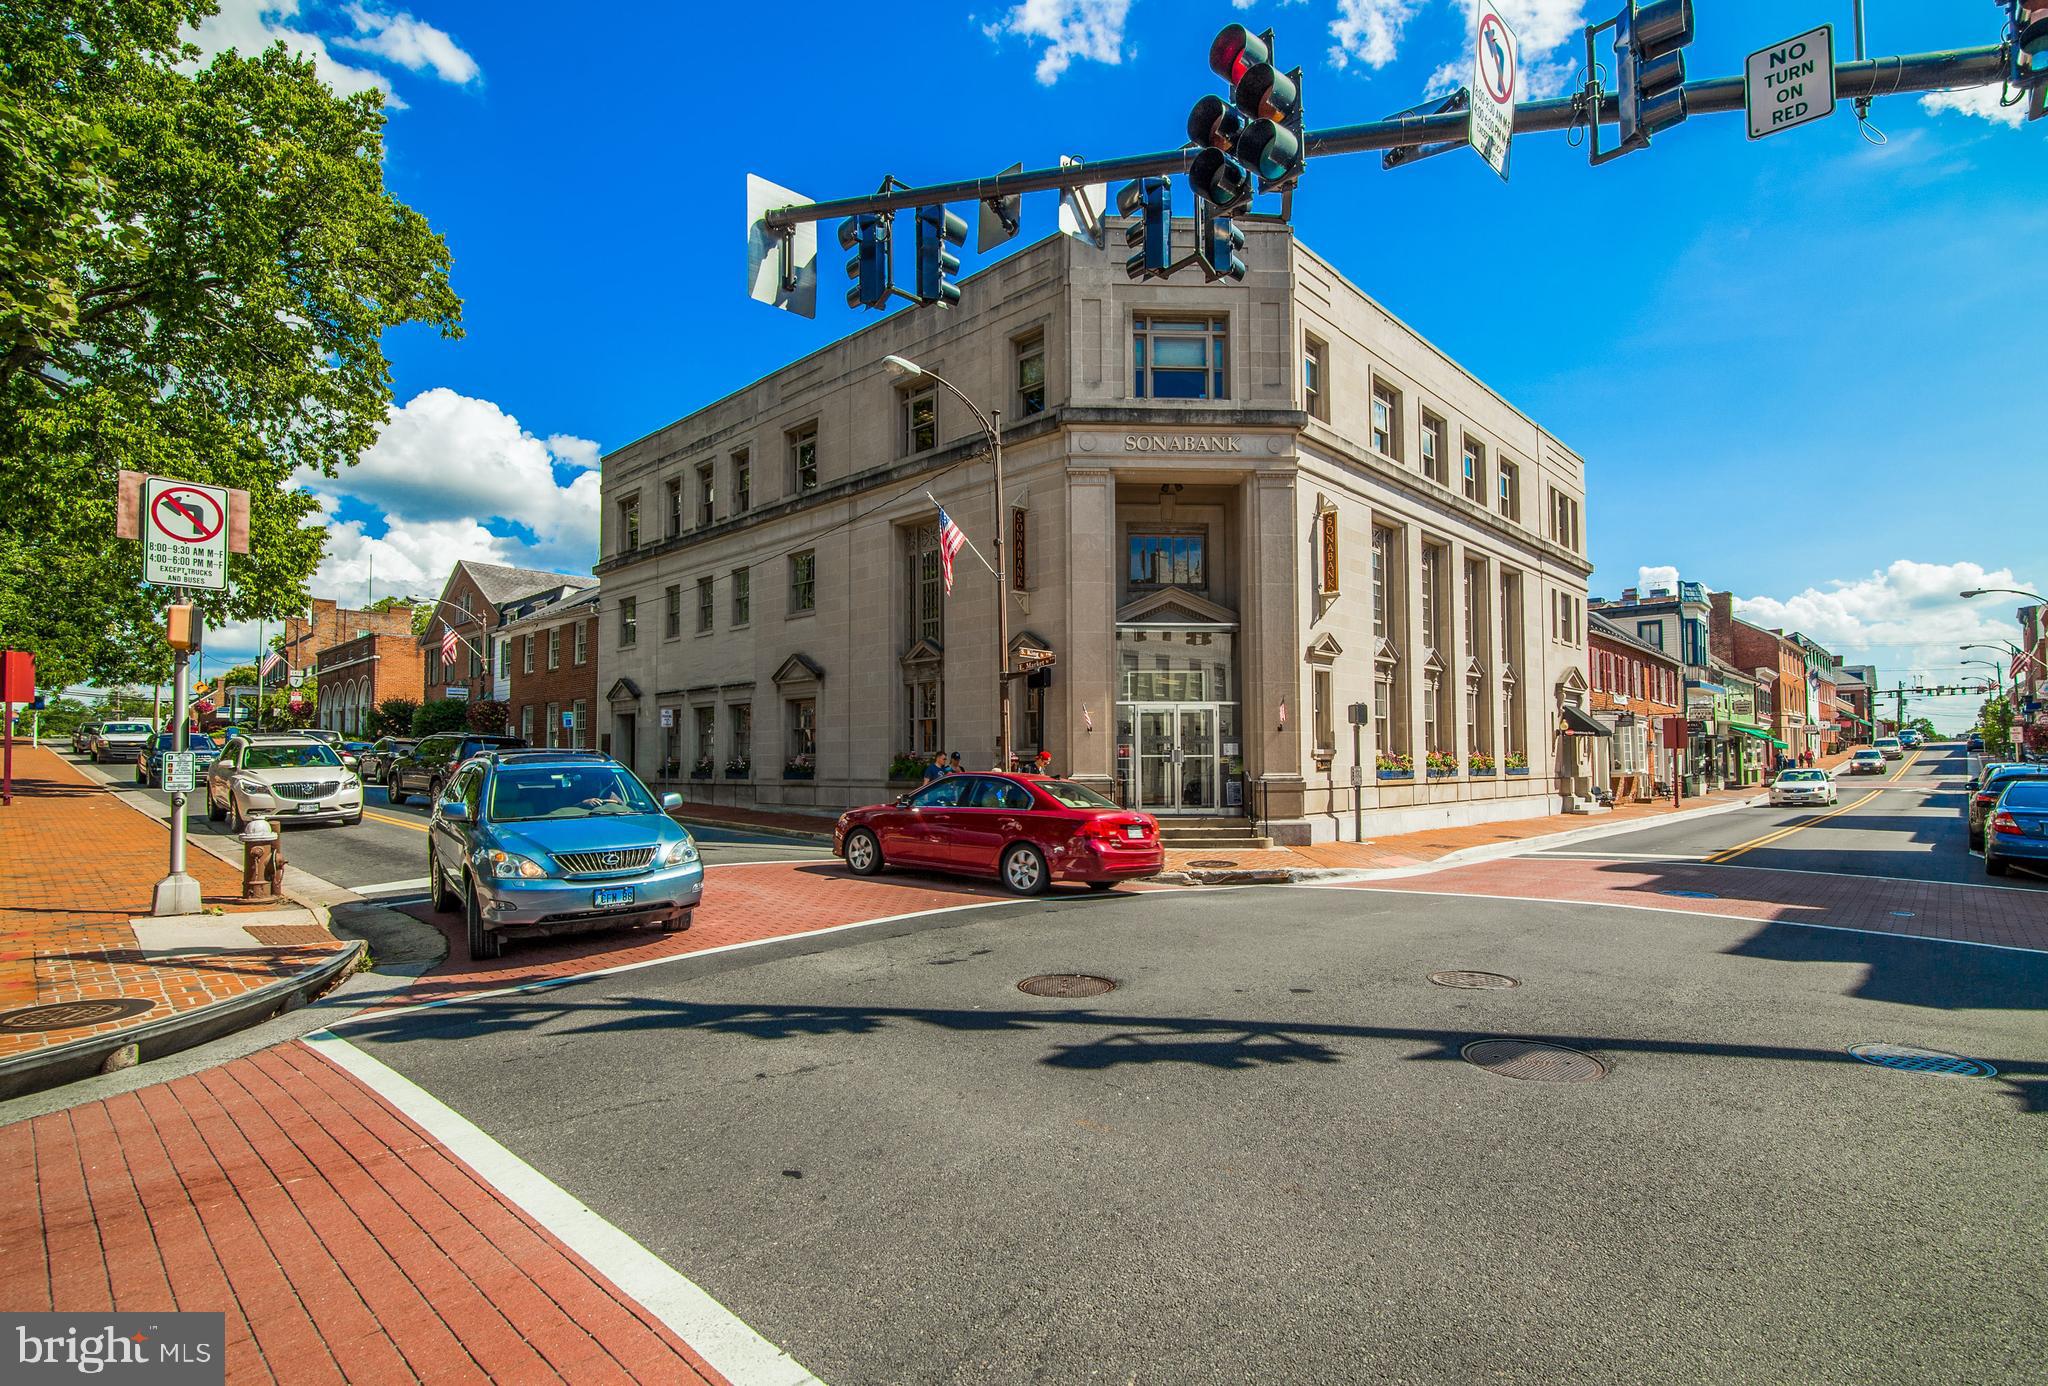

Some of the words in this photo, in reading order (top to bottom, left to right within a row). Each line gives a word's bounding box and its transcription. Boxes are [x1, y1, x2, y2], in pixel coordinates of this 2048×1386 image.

[1769, 42, 1806, 68] NO
[1764, 60, 1814, 88] TURN
[1776, 83, 1803, 103] ON
[1772, 102, 1808, 125] RED
[1124, 435, 1241, 452] SONABANK
[149, 542, 190, 555] 8:00-9:30
[192, 547, 204, 557] AM
[207, 549, 224, 558] M-F
[1016, 511, 1024, 587] SONABANK
[1325, 516, 1335, 588] SONABANK
[149, 554, 190, 566] 4:00-6:00
[192, 558, 204, 567] PM
[206, 560, 223, 569] M-F
[160, 565, 185, 573] EXCEPT
[188, 568, 213, 577] TRUCKS
[183, 576, 205, 585] BUSES
